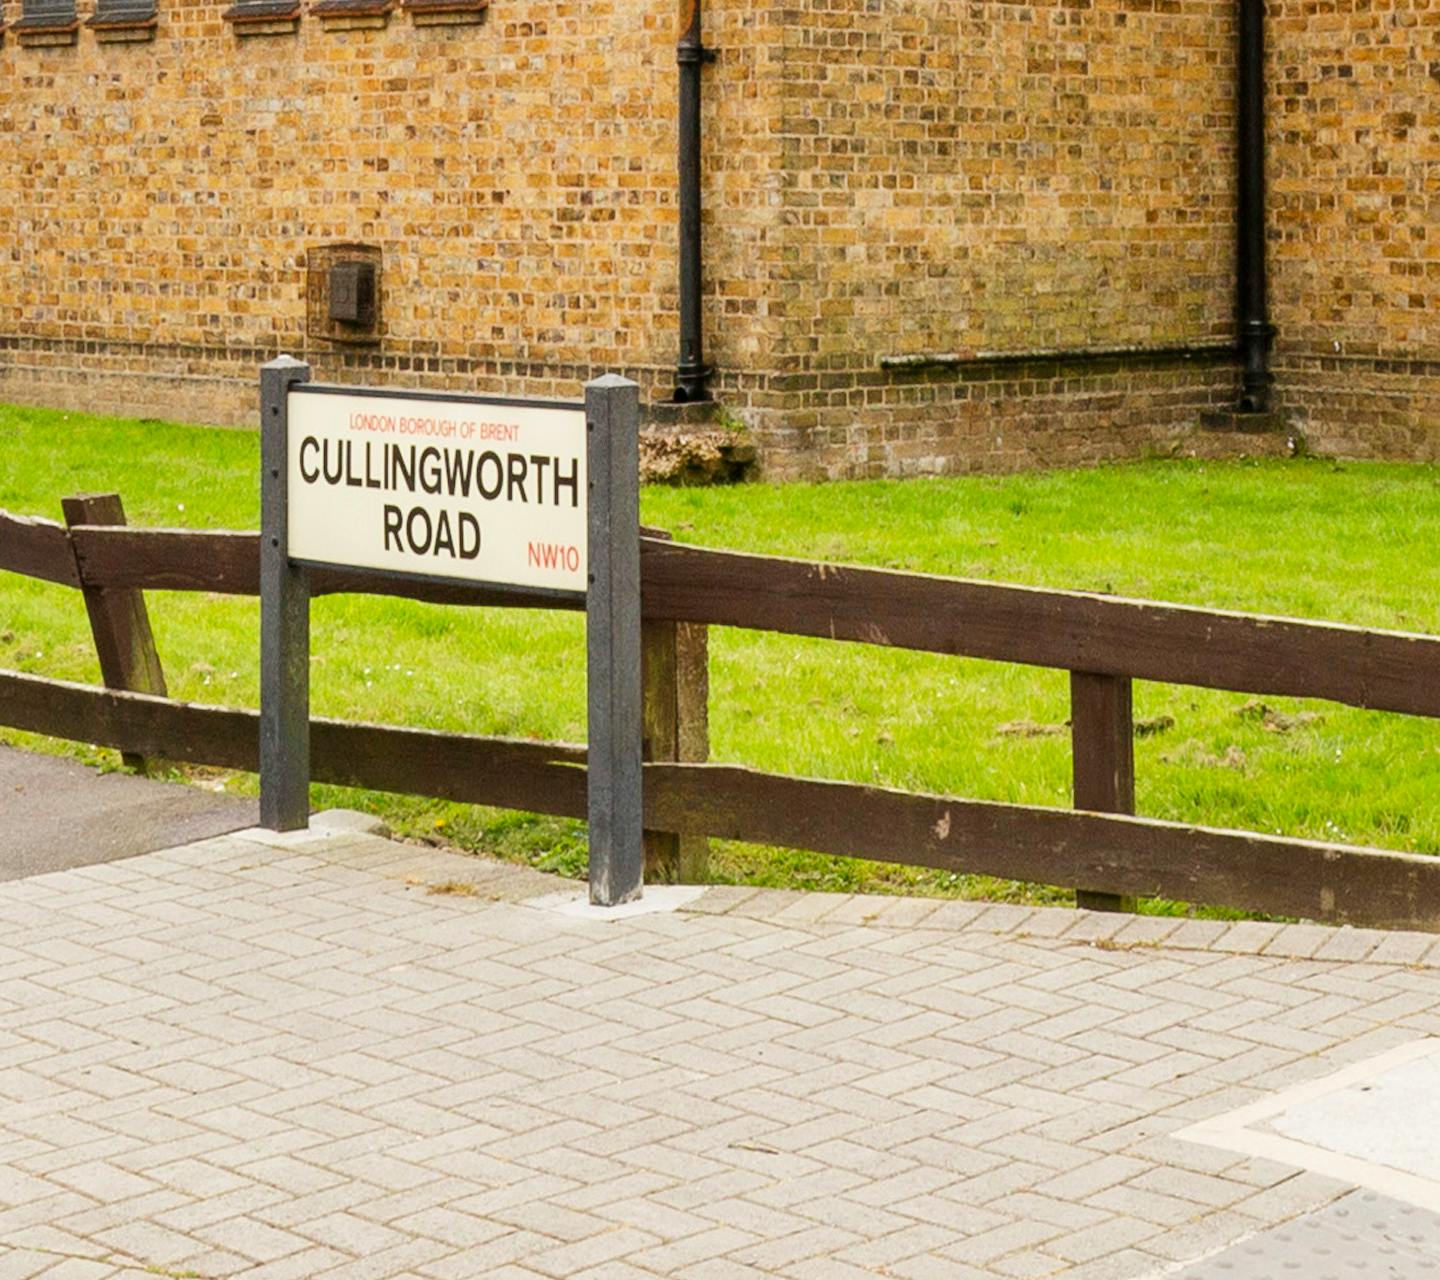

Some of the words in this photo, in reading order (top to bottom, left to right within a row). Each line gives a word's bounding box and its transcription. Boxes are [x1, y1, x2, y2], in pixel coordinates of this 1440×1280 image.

[348, 413, 397, 434] LONDON
[399, 416, 457, 438] BOROUGH
[459, 420, 478, 439] OF
[479, 422, 520, 442] BRENT
[299, 435, 579, 508] CULLINGWORTH
[383, 504, 481, 560] ROAD
[527, 542, 580, 573] NW10
